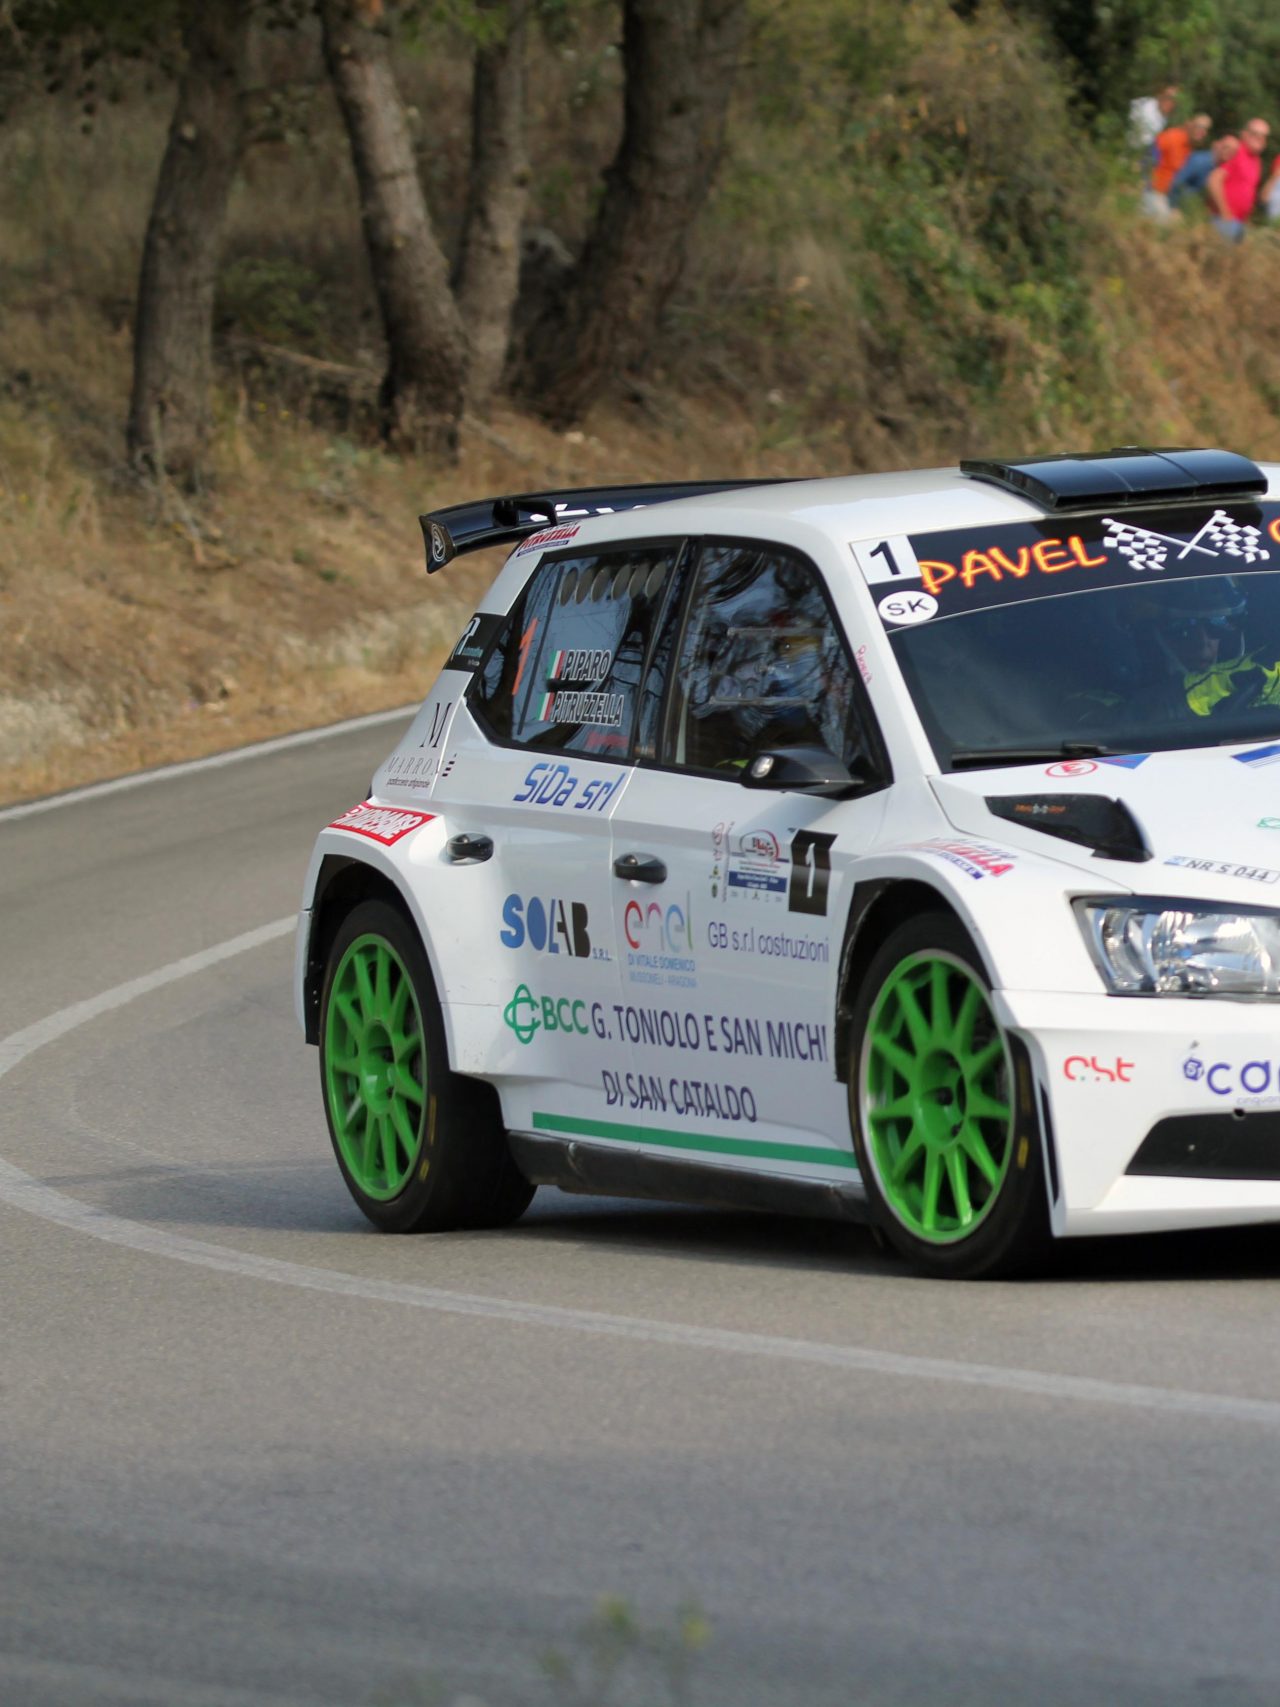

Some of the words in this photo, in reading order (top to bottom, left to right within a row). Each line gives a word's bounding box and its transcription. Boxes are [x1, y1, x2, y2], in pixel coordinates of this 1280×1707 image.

[869, 540, 901, 576] 1
[917, 536, 1108, 594] PAVEL
[886, 598, 931, 617] SK
[512, 617, 538, 695] 1
[561, 649, 612, 682] PIPARO
[419, 702, 452, 748] M
[550, 691, 625, 727] PITRUZZELLA
[513, 762, 578, 806] SiDa
[574, 772, 626, 812] srl
[805, 842, 816, 898] 1
[500, 893, 591, 959] SOLAB
[624, 889, 693, 951] enel
[708, 921, 728, 949] GB
[758, 932, 829, 963] costruzioni
[659, 956, 696, 972] DOMENICO
[540, 995, 590, 1035] BCC
[591, 1002, 612, 1040] G.
[613, 1005, 701, 1050] TONIOLO
[704, 1015, 718, 1052] E
[720, 1016, 764, 1057] SAN
[601, 1069, 622, 1107] DI
[626, 1072, 667, 1113] SAN
[669, 1078, 757, 1123] CATALDO
